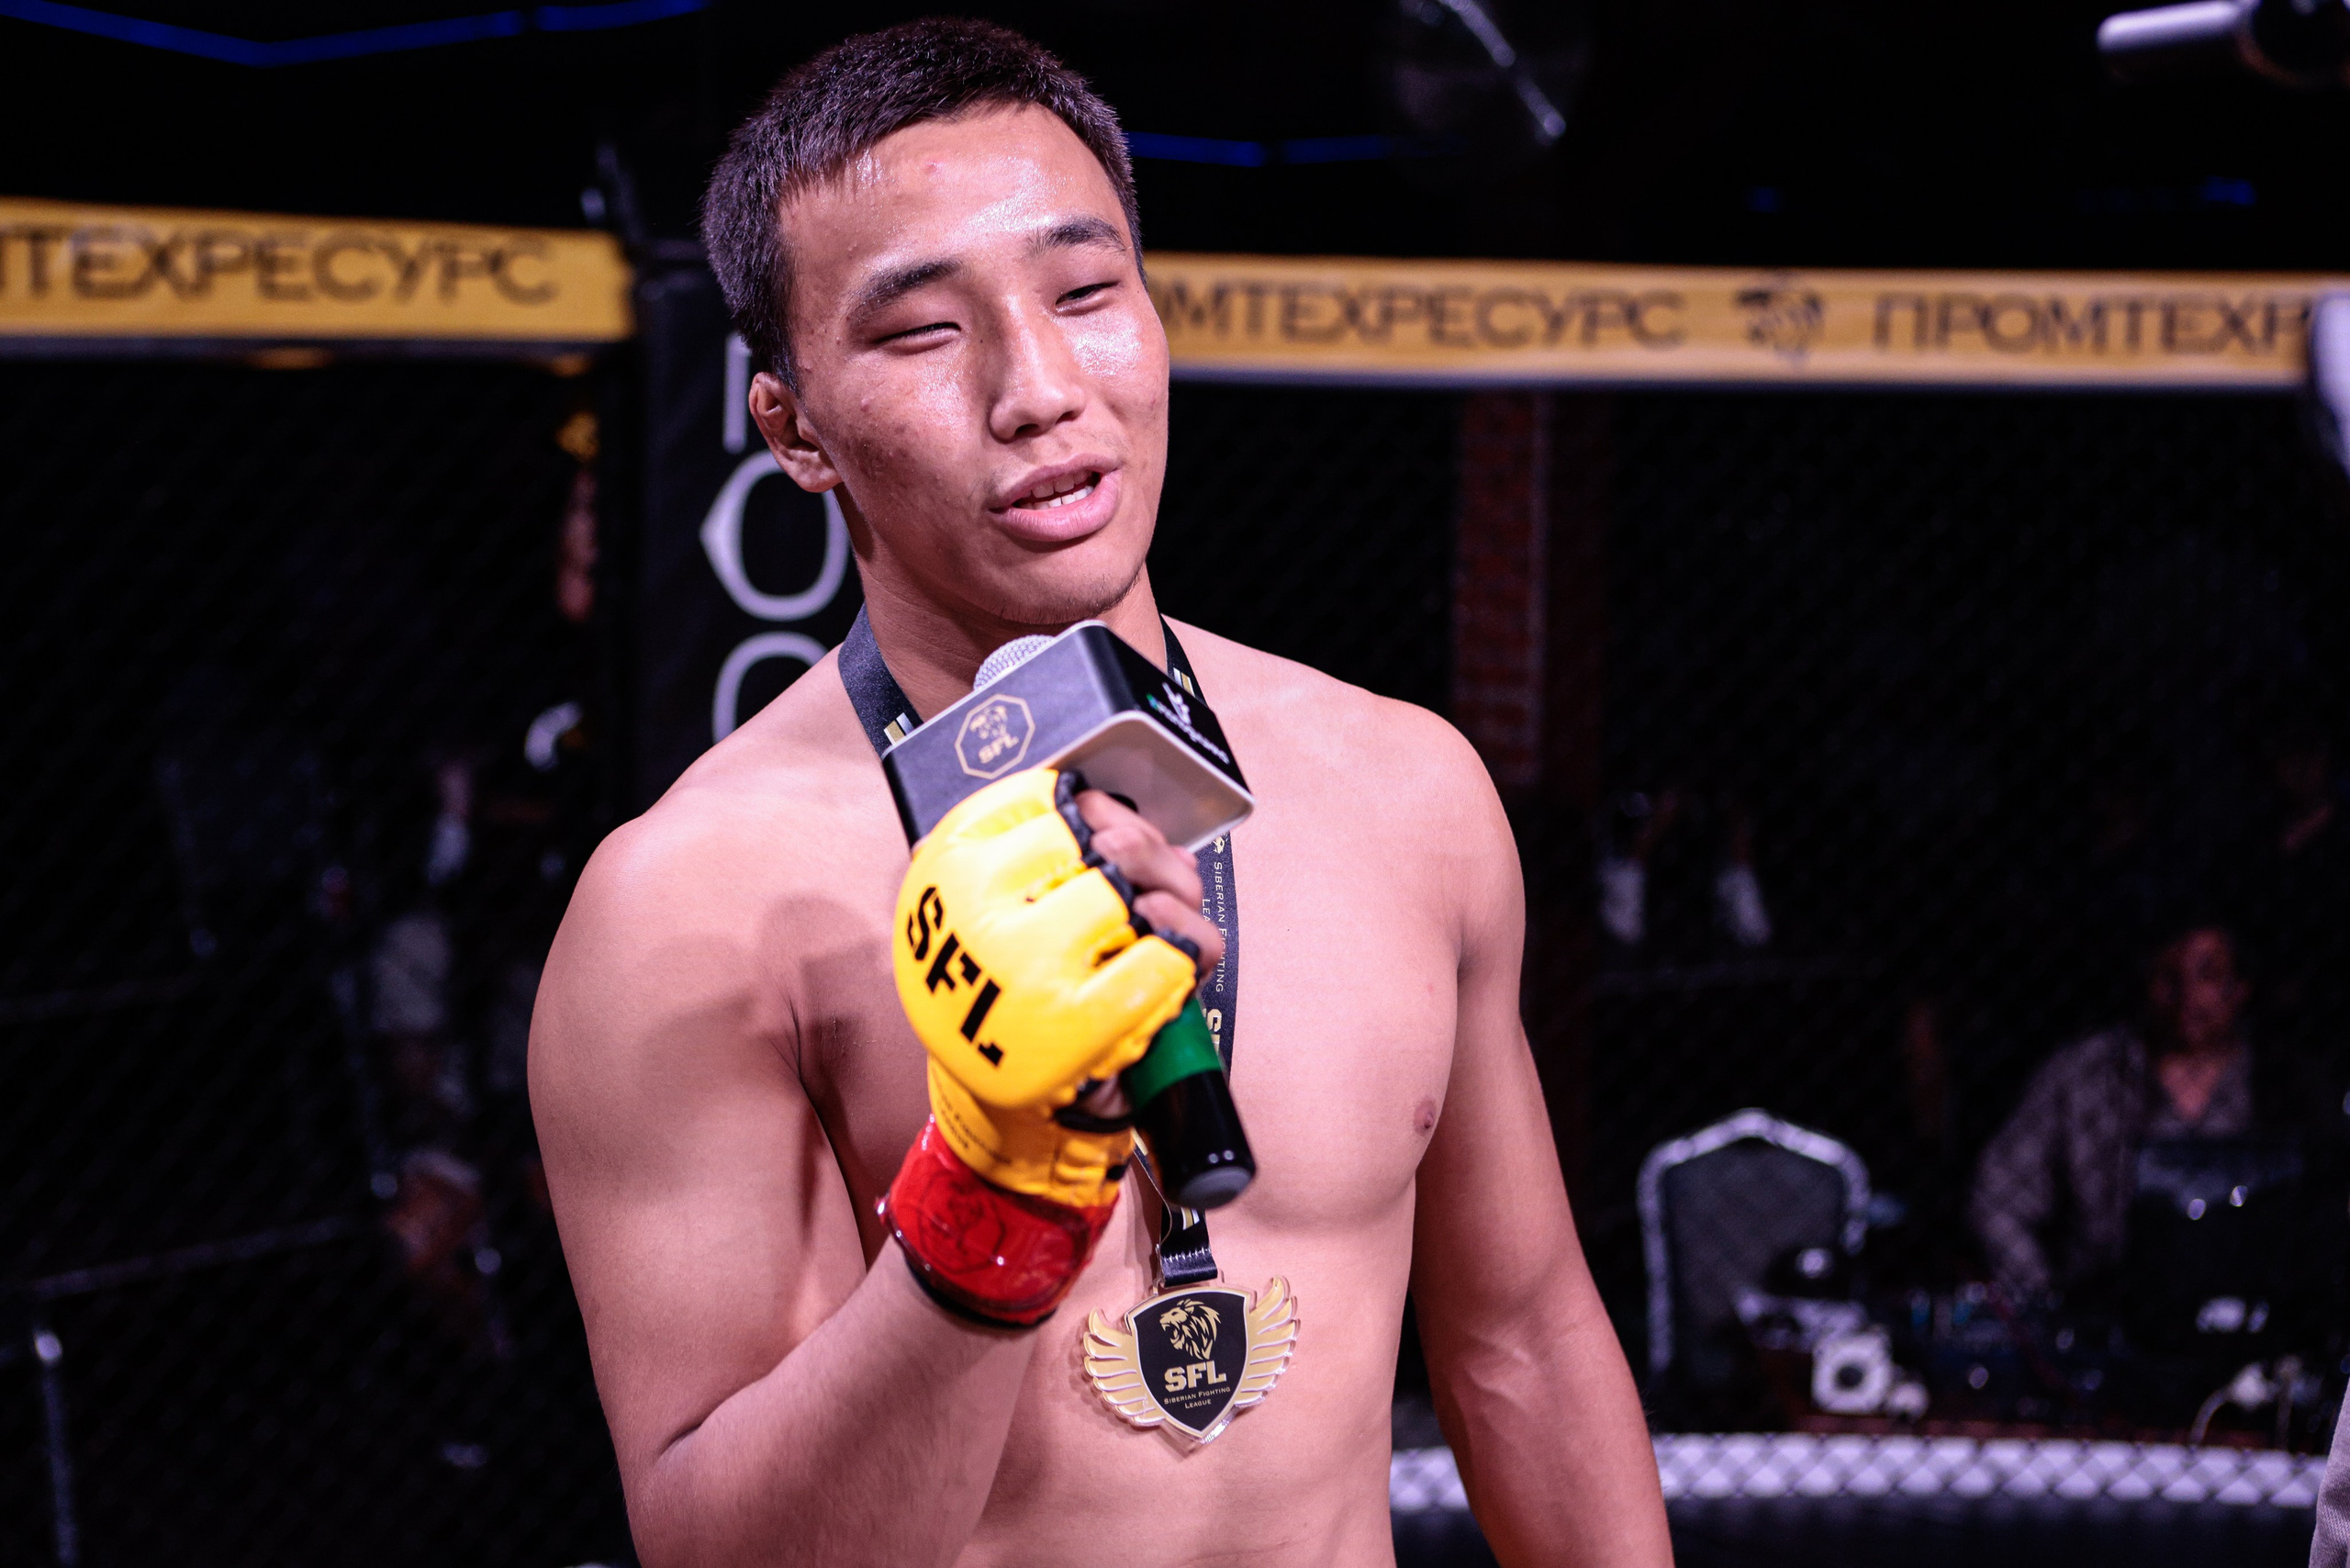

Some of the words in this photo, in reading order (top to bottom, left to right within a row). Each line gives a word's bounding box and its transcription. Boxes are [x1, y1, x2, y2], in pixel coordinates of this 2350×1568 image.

[0, 224, 558, 307] ТЕХРЕСУРС
[979, 733, 1019, 764] SFL
[1214, 861, 1225, 923] SIBERIAN
[907, 886, 1003, 1068] SFL
[1164, 1360, 1227, 1393] SFL
[1163, 1394, 1196, 1405] SIBERIAN
[1198, 1386, 1231, 1398] FIGHTING
[1184, 1399, 1212, 1409] LEAGUE
